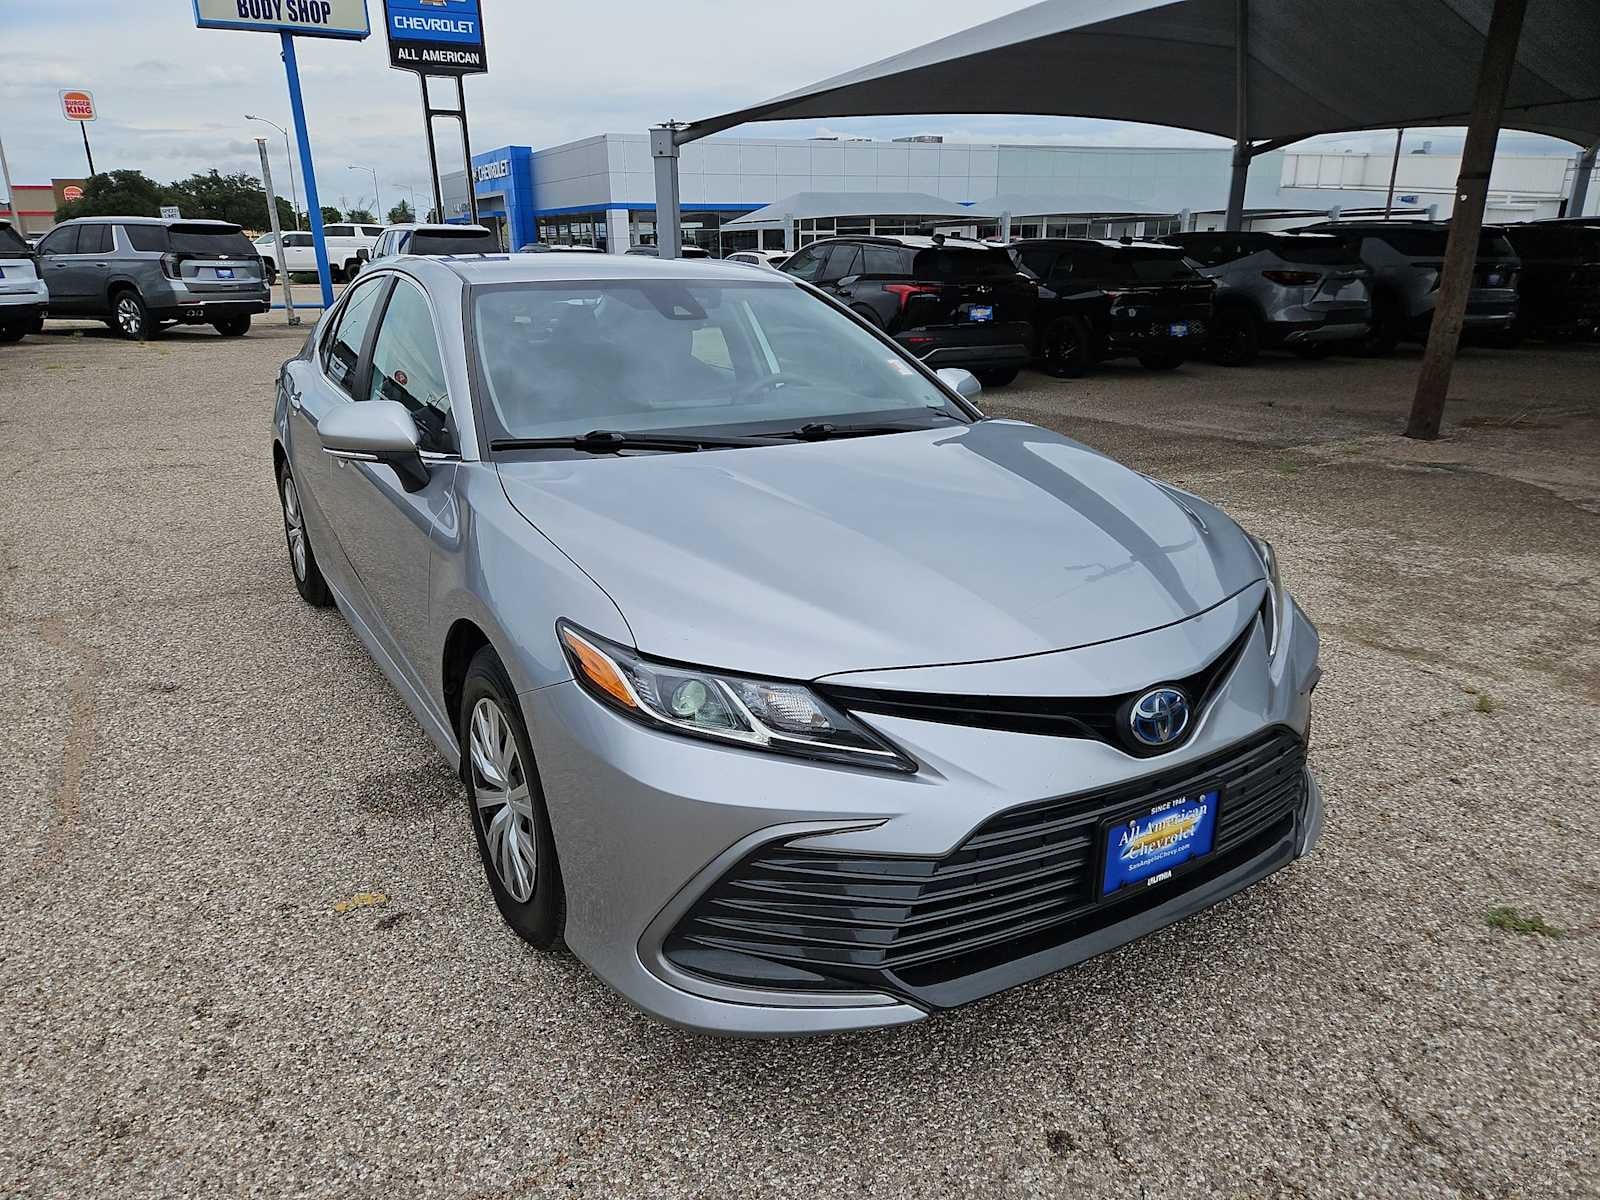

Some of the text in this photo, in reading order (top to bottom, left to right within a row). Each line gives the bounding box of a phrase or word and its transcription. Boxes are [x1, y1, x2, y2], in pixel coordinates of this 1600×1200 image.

[236, 0, 331, 24] BODY SHOP
[394, 15, 474, 34] CHEVROLET
[398, 47, 480, 64] ALL AMERICAN
[66, 105, 93, 114] KING
[478, 160, 512, 181] CHEVROLET
[1151, 801, 1172, 815] SINCE
[1118, 804, 1207, 847] All American
[1129, 825, 1195, 859] Chevrolet
